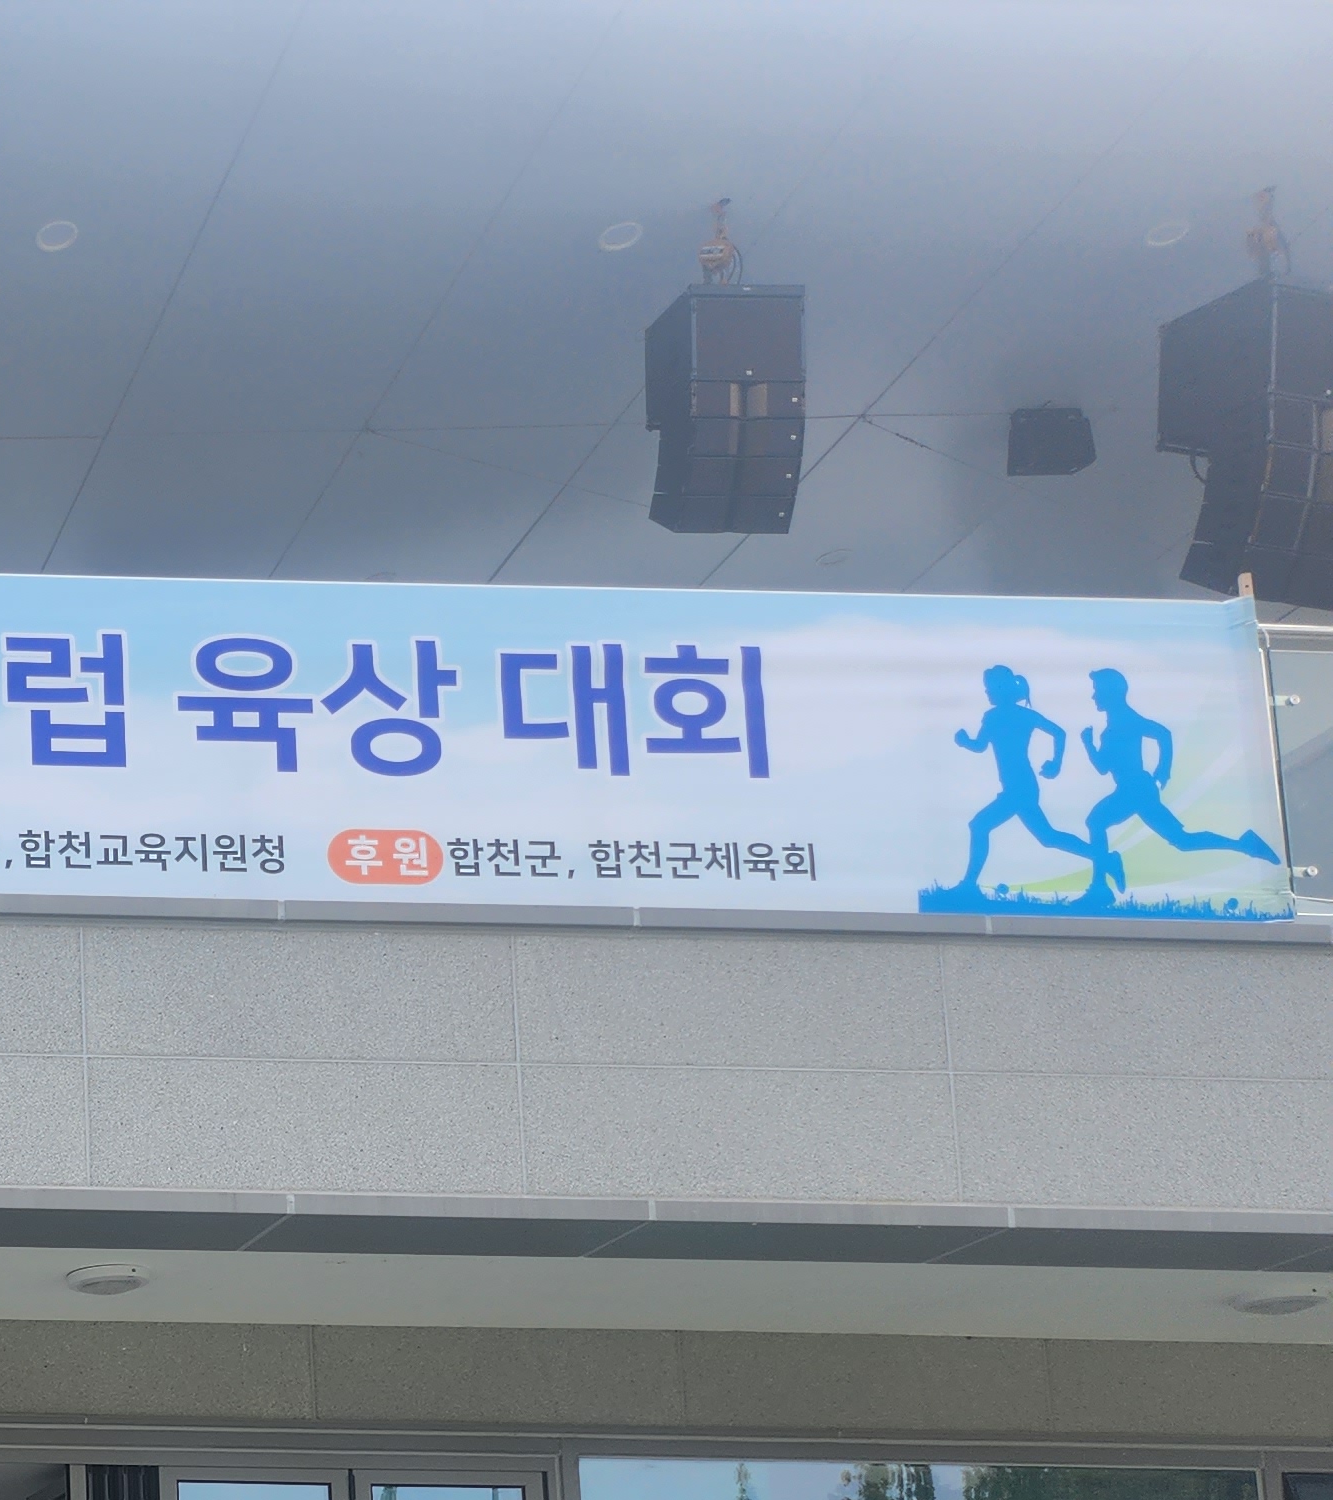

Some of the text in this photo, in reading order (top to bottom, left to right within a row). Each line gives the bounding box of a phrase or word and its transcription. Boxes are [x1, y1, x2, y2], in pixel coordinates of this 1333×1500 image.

[178, 638, 455, 776] 육상
[503, 644, 770, 778] 대회
[345, 836, 817, 883] 후원 합천군, 합천군체육회
